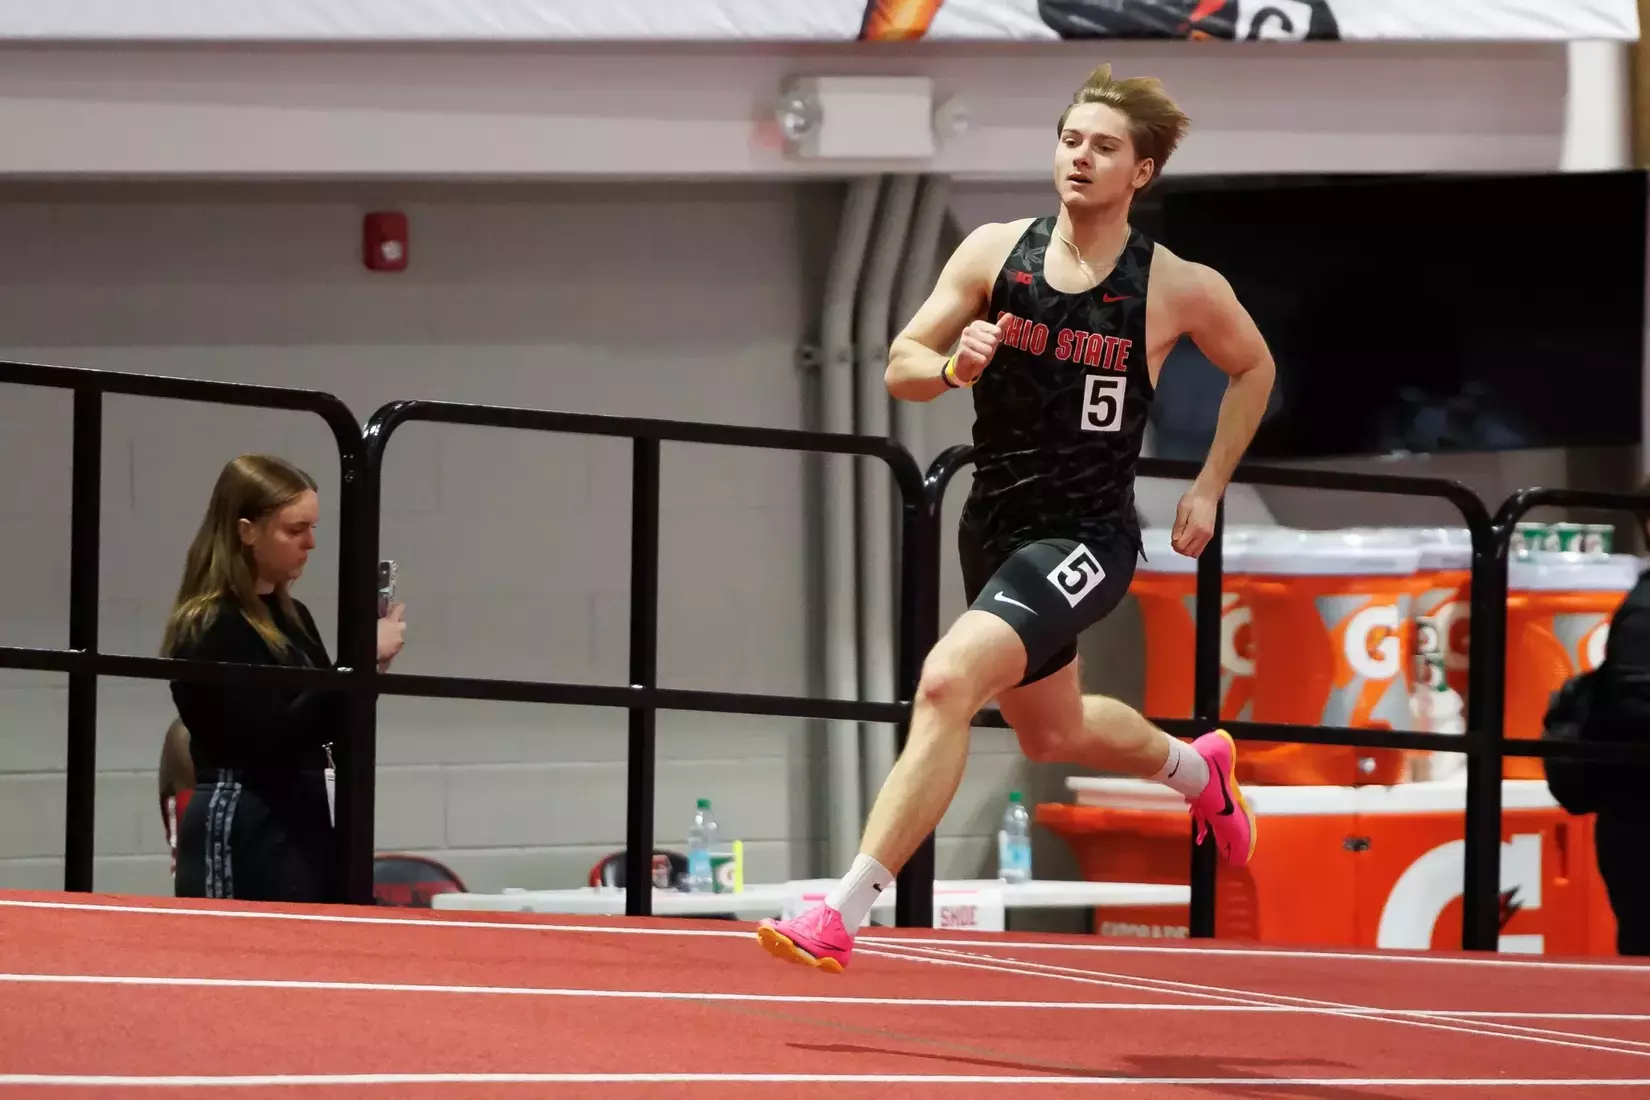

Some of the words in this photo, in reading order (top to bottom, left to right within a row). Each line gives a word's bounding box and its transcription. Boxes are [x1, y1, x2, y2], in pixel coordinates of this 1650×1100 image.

[1055, 328, 1132, 372] STATE
[1087, 379, 1118, 427] 5
[1057, 552, 1099, 596] 5
[1345, 604, 1400, 681] G
